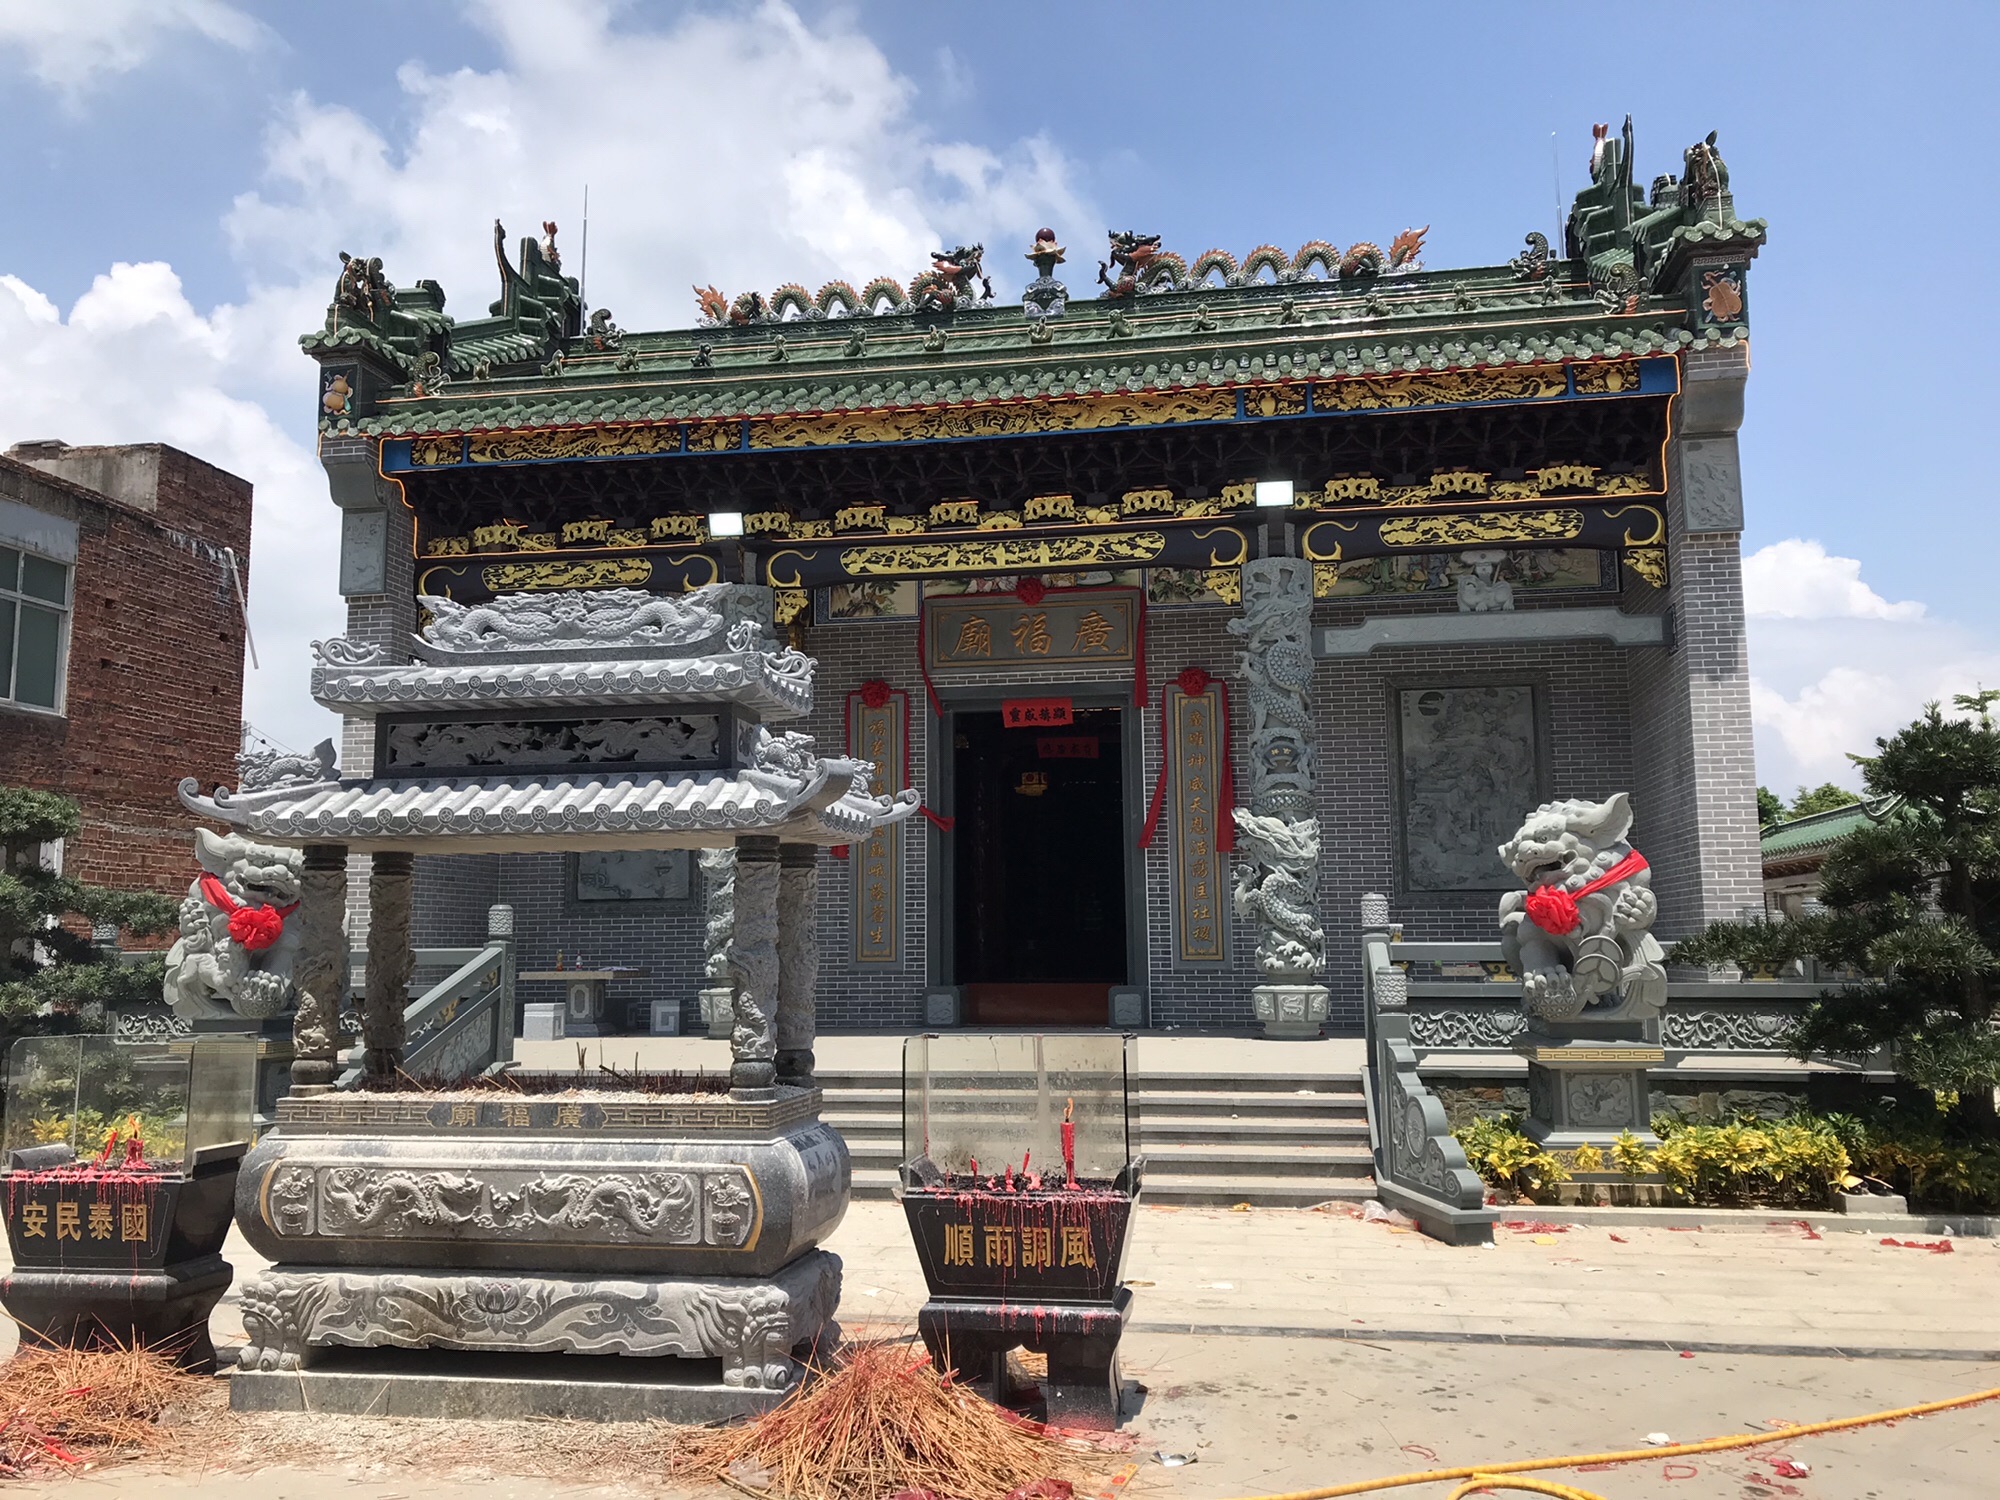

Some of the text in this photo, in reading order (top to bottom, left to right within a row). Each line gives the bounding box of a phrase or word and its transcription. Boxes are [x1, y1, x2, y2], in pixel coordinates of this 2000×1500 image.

[952, 609, 1115, 657] 廣福廟
[447, 1100, 585, 1130] 廣福廟
[22, 1200, 148, 1242] 國泰民安
[944, 1223, 1095, 1268] 風調雨順
